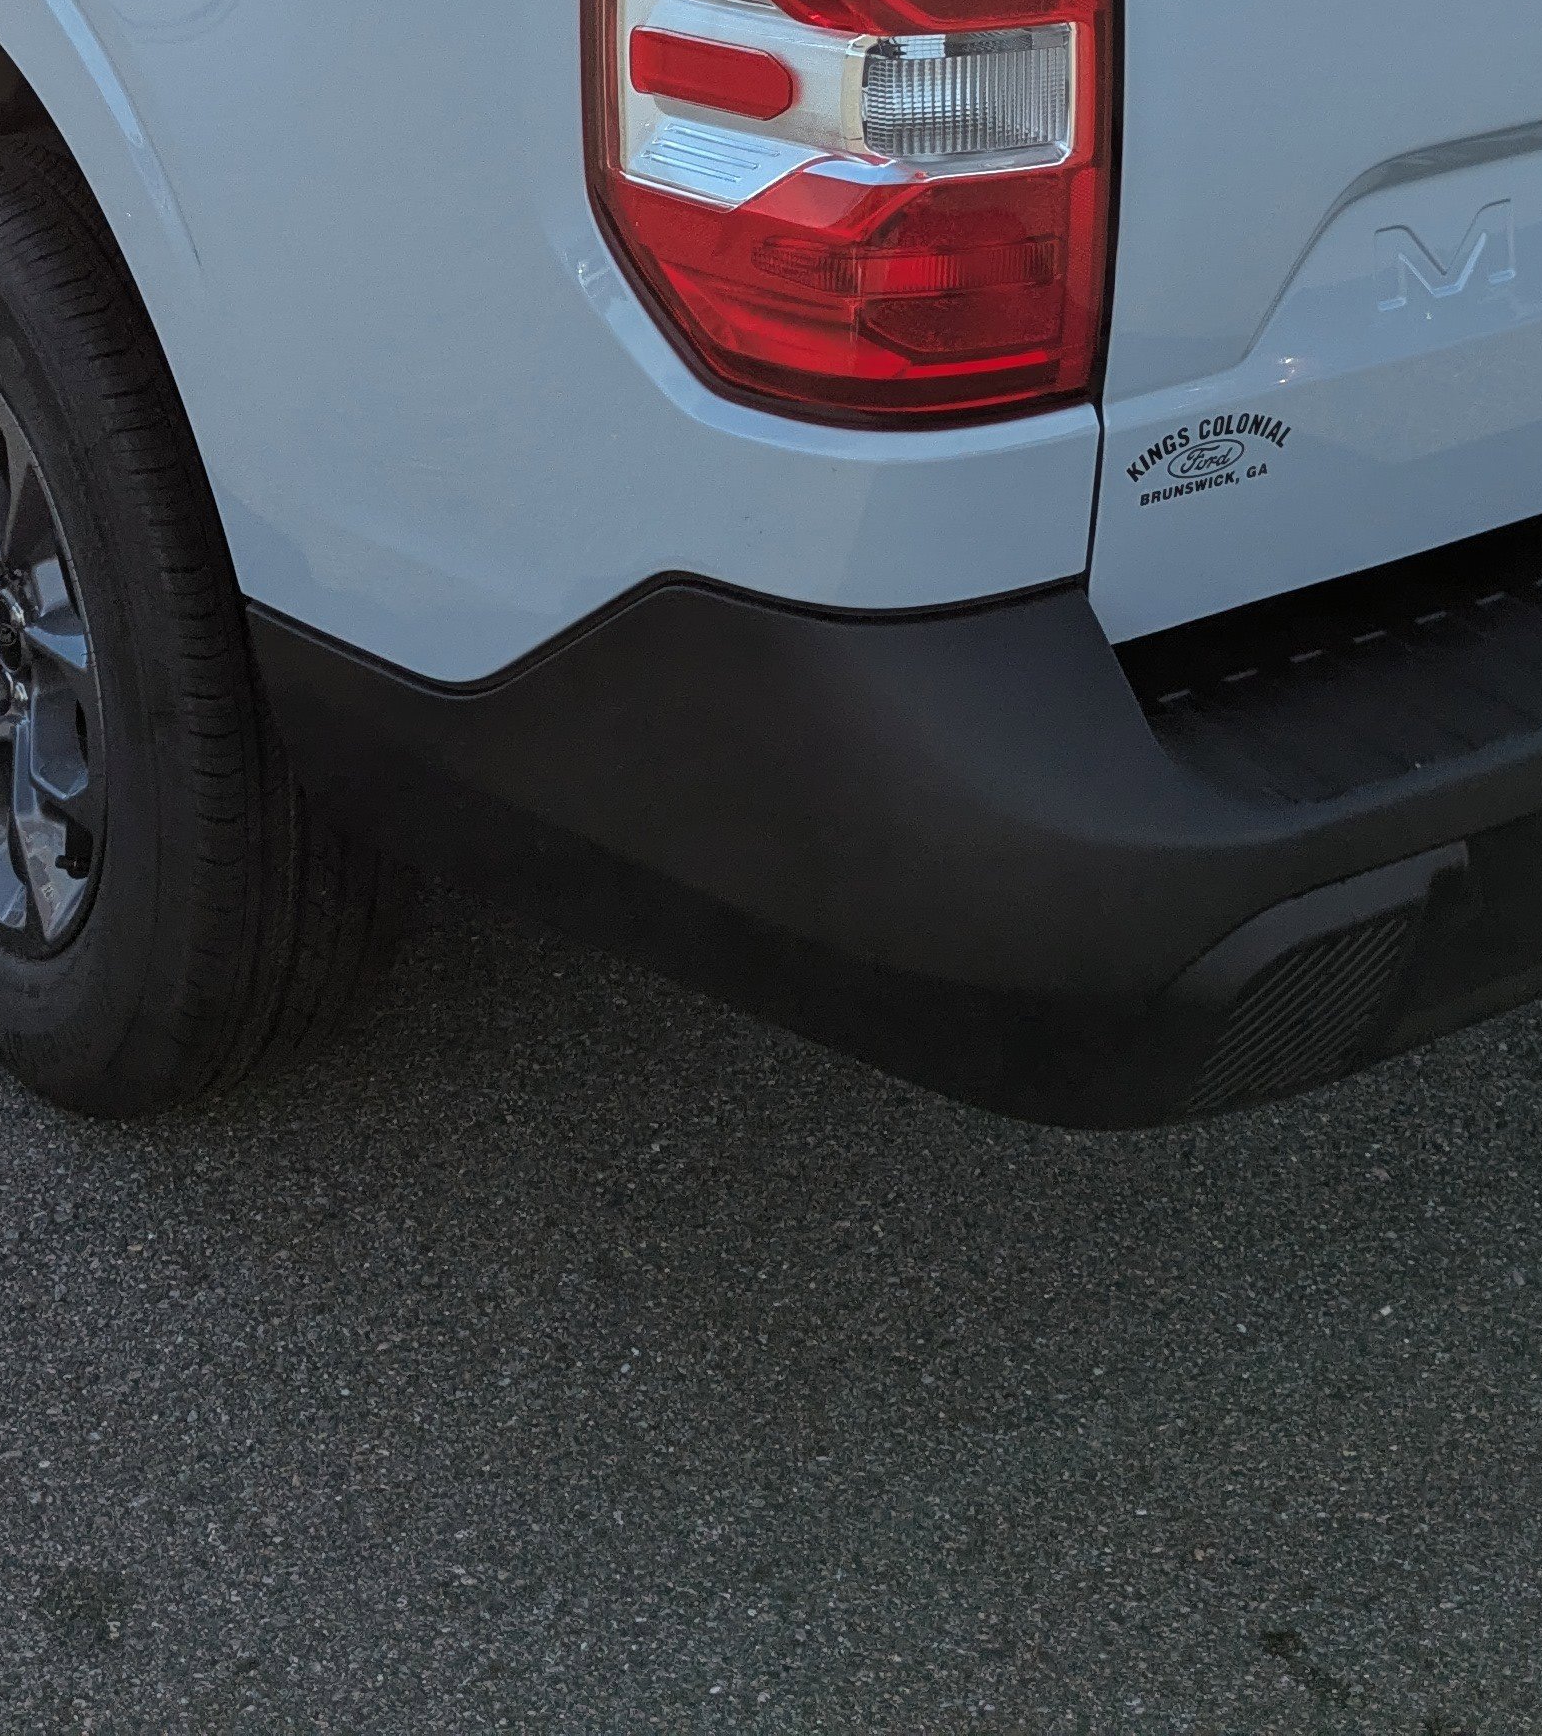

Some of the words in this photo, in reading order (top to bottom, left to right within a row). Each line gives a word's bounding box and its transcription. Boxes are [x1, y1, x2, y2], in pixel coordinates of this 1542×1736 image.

[1126, 426, 1191, 483] KINGS
[1198, 412, 1292, 449] COLONIAL
[1179, 444, 1234, 475] Ford
[1139, 470, 1241, 507] BRUNSWICK,
[1245, 462, 1269, 479] GA
